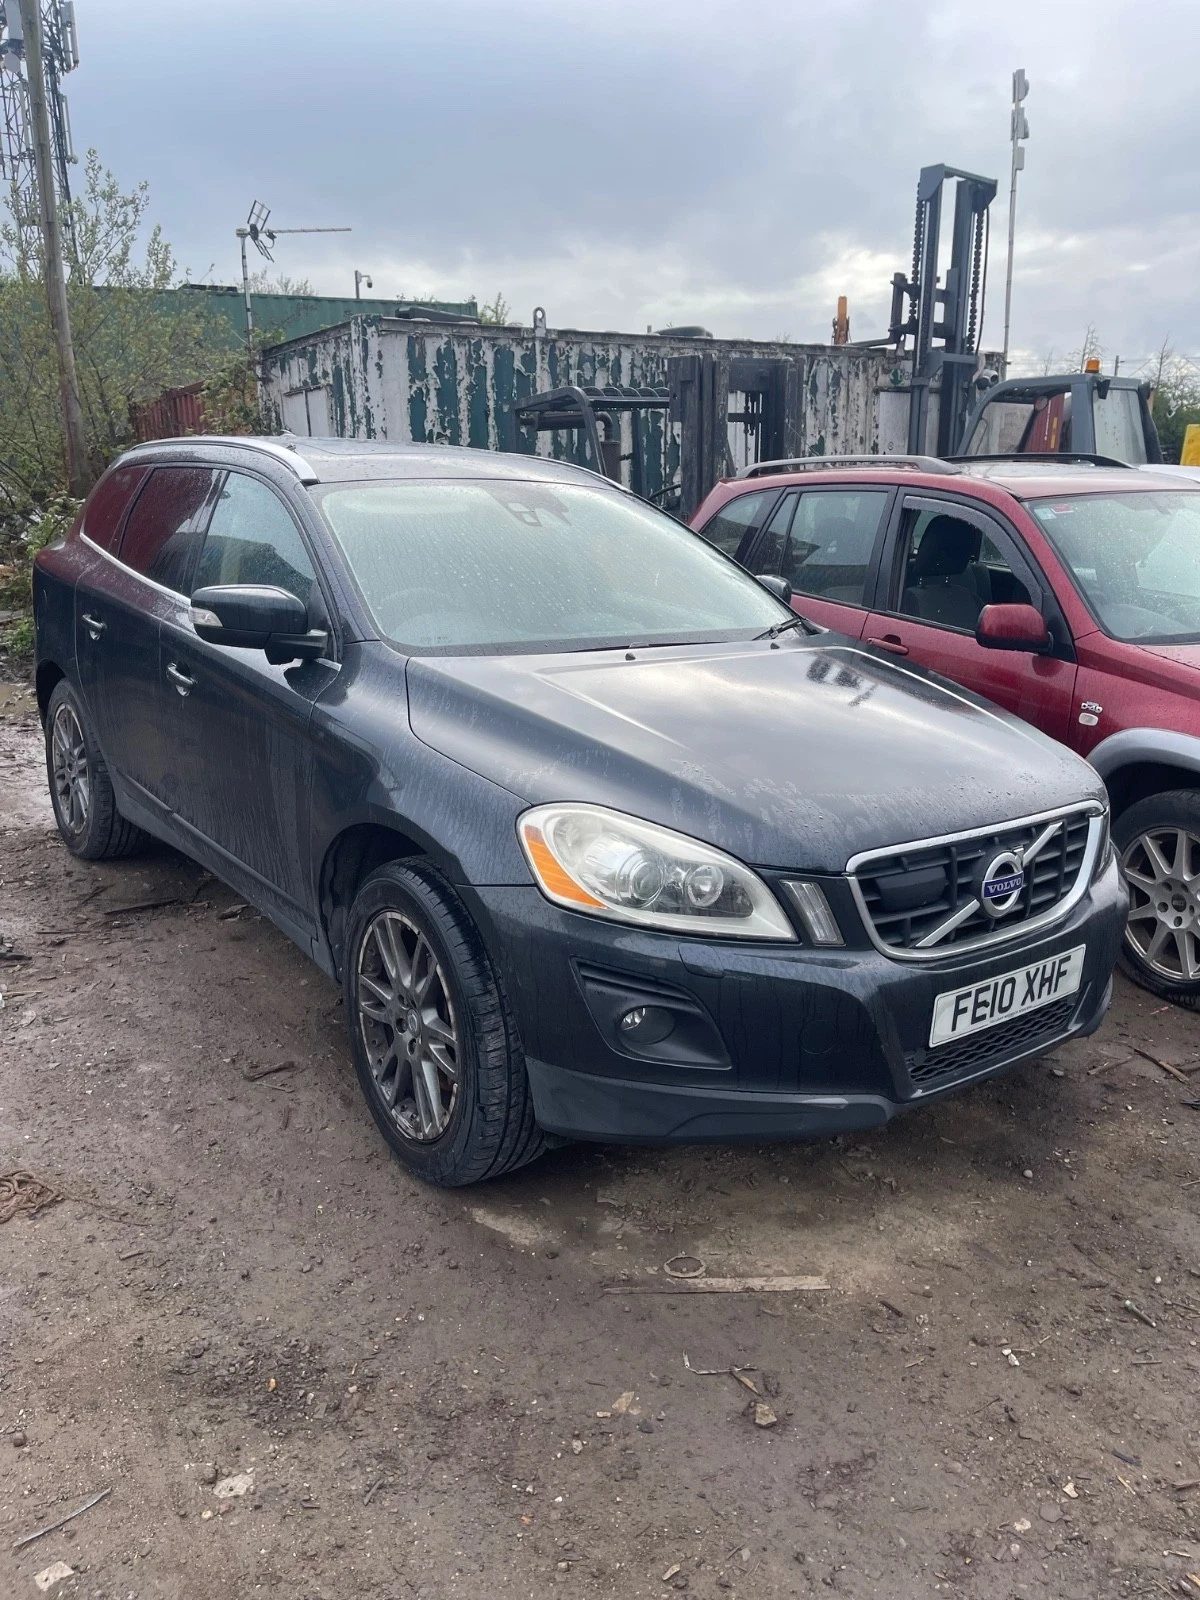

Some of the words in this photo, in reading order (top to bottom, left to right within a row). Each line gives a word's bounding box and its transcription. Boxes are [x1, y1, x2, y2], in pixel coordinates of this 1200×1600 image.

[987, 877, 1022, 894] VOLVO
[951, 976, 1017, 1032] FE10
[1021, 955, 1072, 1006] XHF
